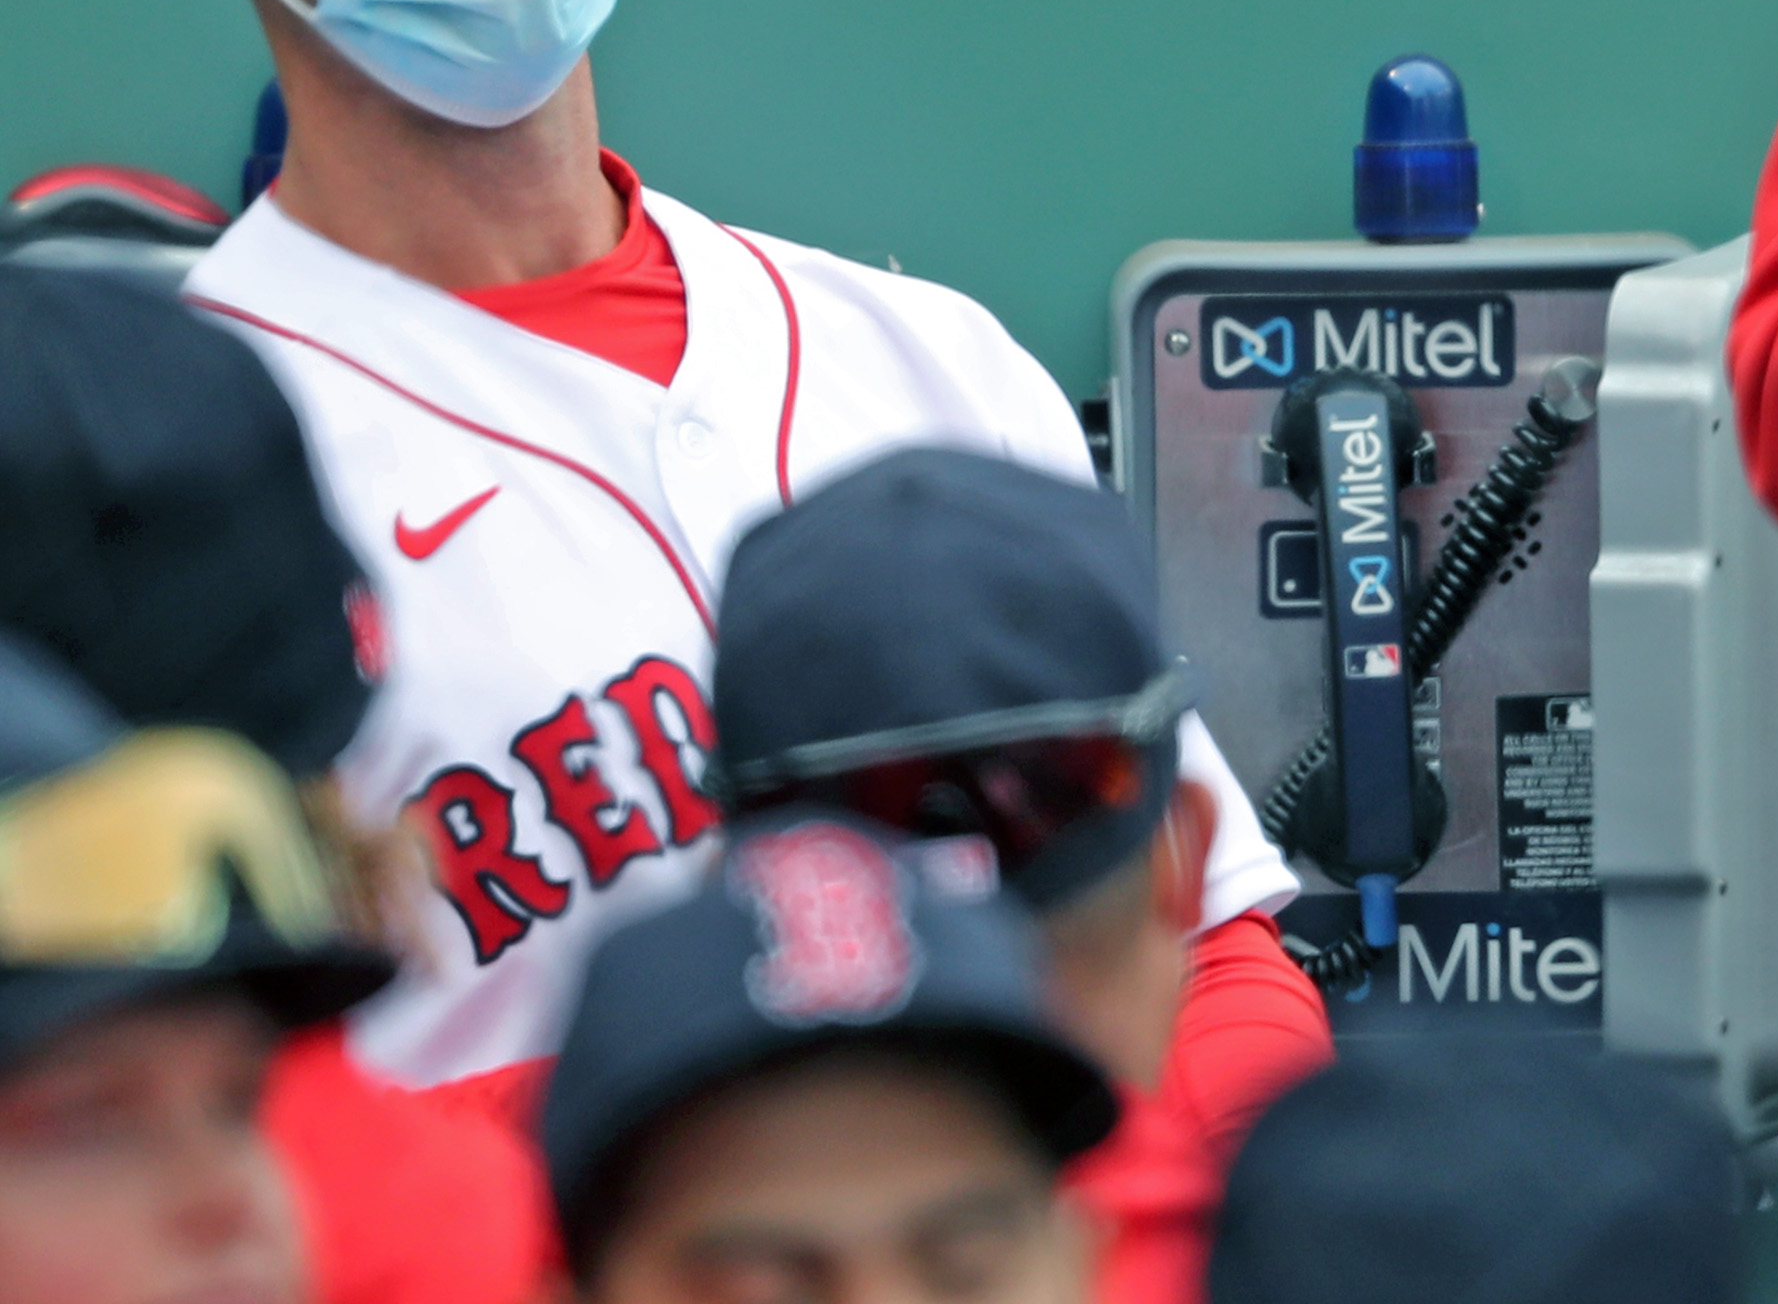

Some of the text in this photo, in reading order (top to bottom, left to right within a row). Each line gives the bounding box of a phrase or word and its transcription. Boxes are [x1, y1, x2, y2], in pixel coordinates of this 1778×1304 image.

[1313, 303, 1501, 377] Mitel
[1329, 415, 1390, 543] Mitel
[1399, 922, 1600, 1003] Mite
